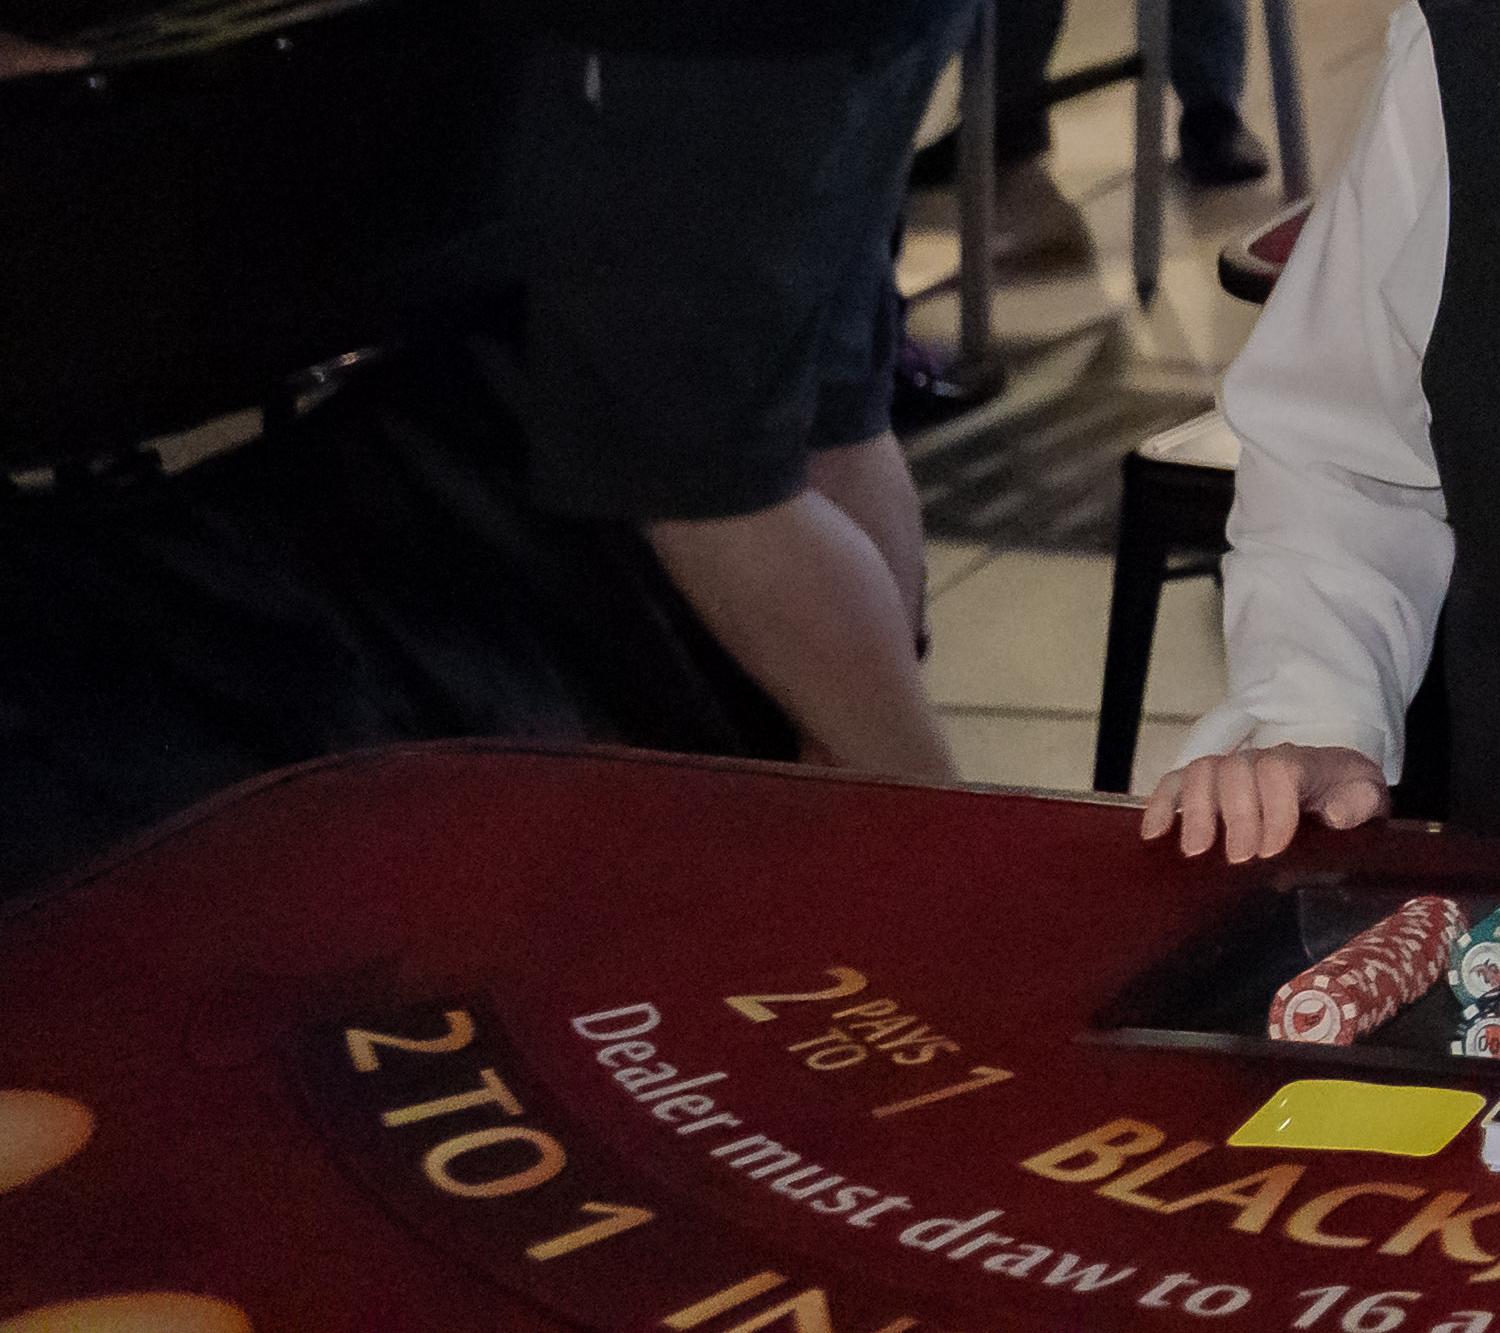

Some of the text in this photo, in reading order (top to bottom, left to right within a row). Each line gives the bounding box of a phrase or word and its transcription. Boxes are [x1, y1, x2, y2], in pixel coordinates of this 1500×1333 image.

[345, 1010, 655, 1261] 2 TO 1
[570, 1002, 743, 1134] Dealer
[709, 1133, 912, 1227] must
[899, 1209, 1137, 1292] draw
[1137, 1271, 1252, 1317] to
[1293, 1285, 1423, 1333] 16
[723, 966, 1015, 1119] 2 PAYS TO 1
